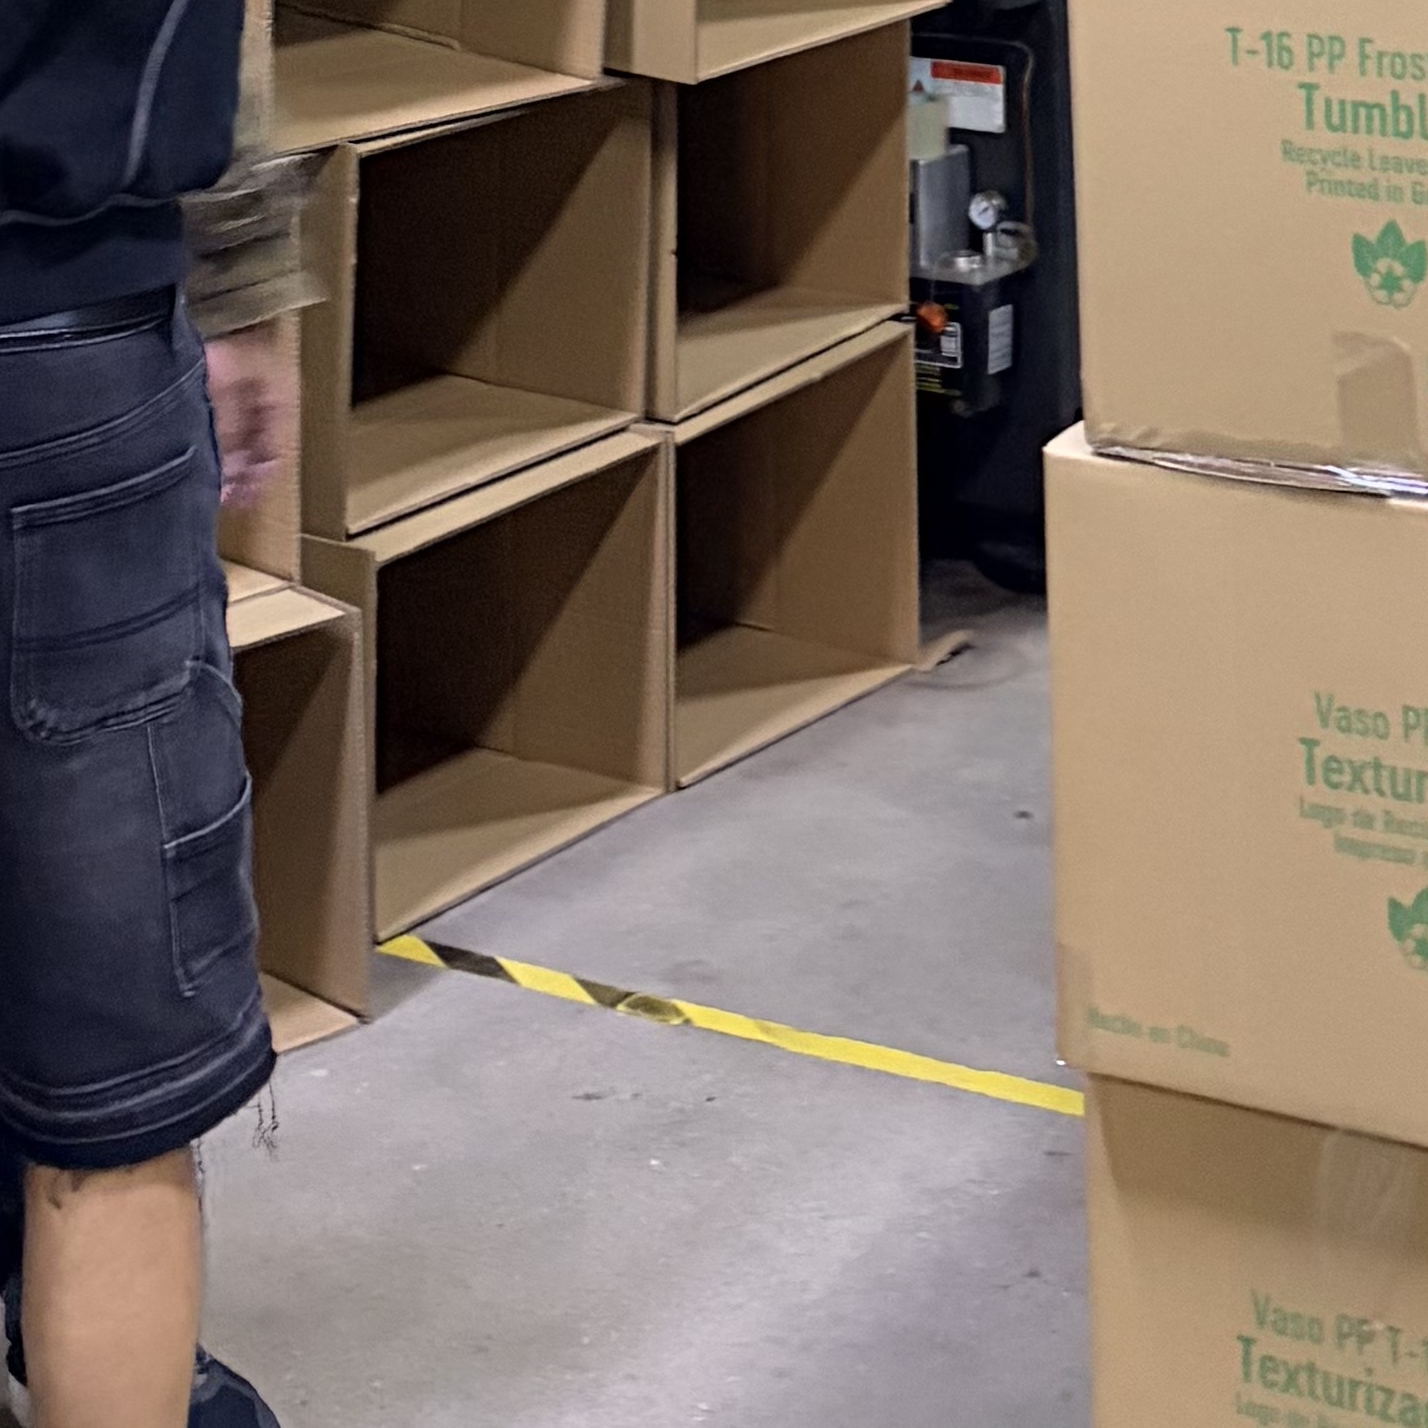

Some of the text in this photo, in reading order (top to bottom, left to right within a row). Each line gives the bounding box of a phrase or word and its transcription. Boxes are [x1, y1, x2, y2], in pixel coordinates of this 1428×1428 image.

[1224, 26, 1294, 71] T-16
[1305, 32, 1346, 75] PP
[1280, 139, 1361, 170] Recycle
[1305, 169, 1380, 202] Printed
[1385, 176, 1405, 202] in
[1313, 690, 1391, 741] Vaso
[1250, 1288, 1324, 1345] Vaso
